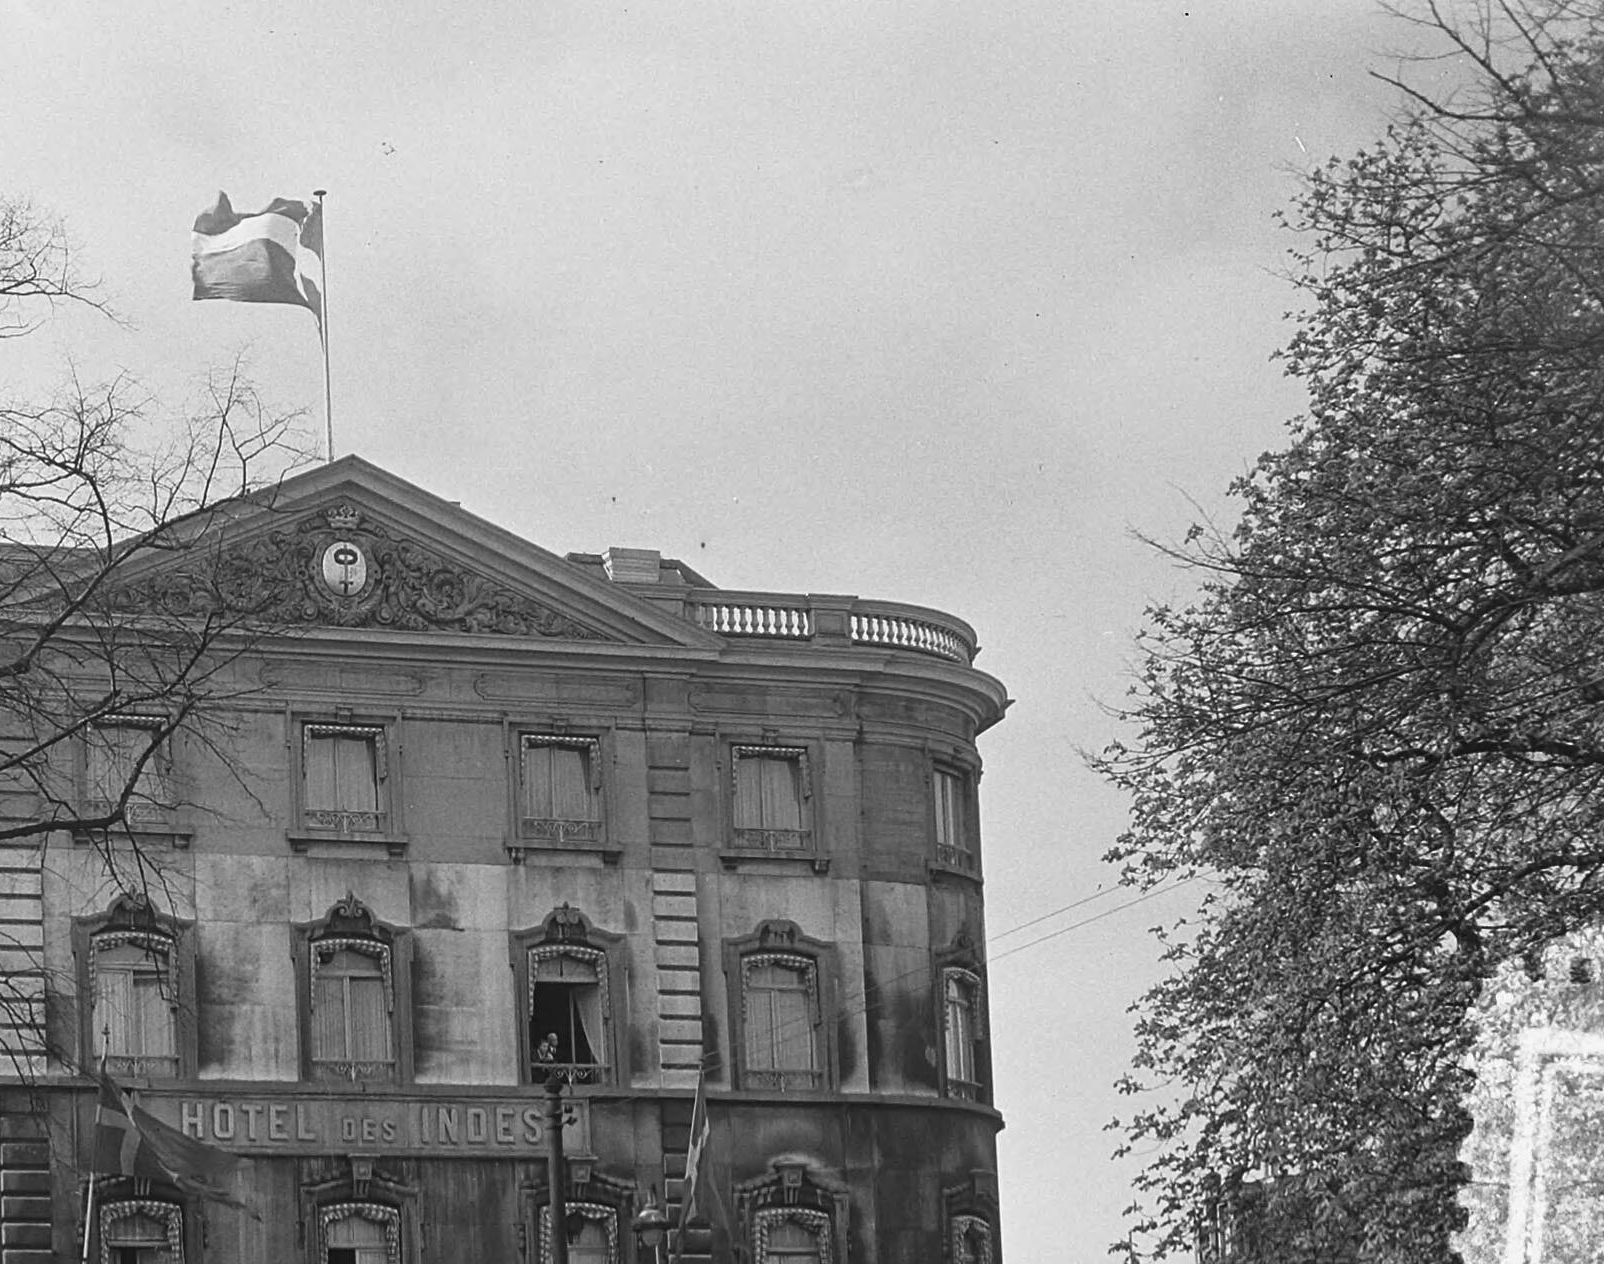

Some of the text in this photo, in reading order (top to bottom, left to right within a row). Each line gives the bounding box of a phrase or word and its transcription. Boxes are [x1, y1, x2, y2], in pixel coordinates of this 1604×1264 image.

[181, 1101, 543, 1145] HOTEL DES INDES
